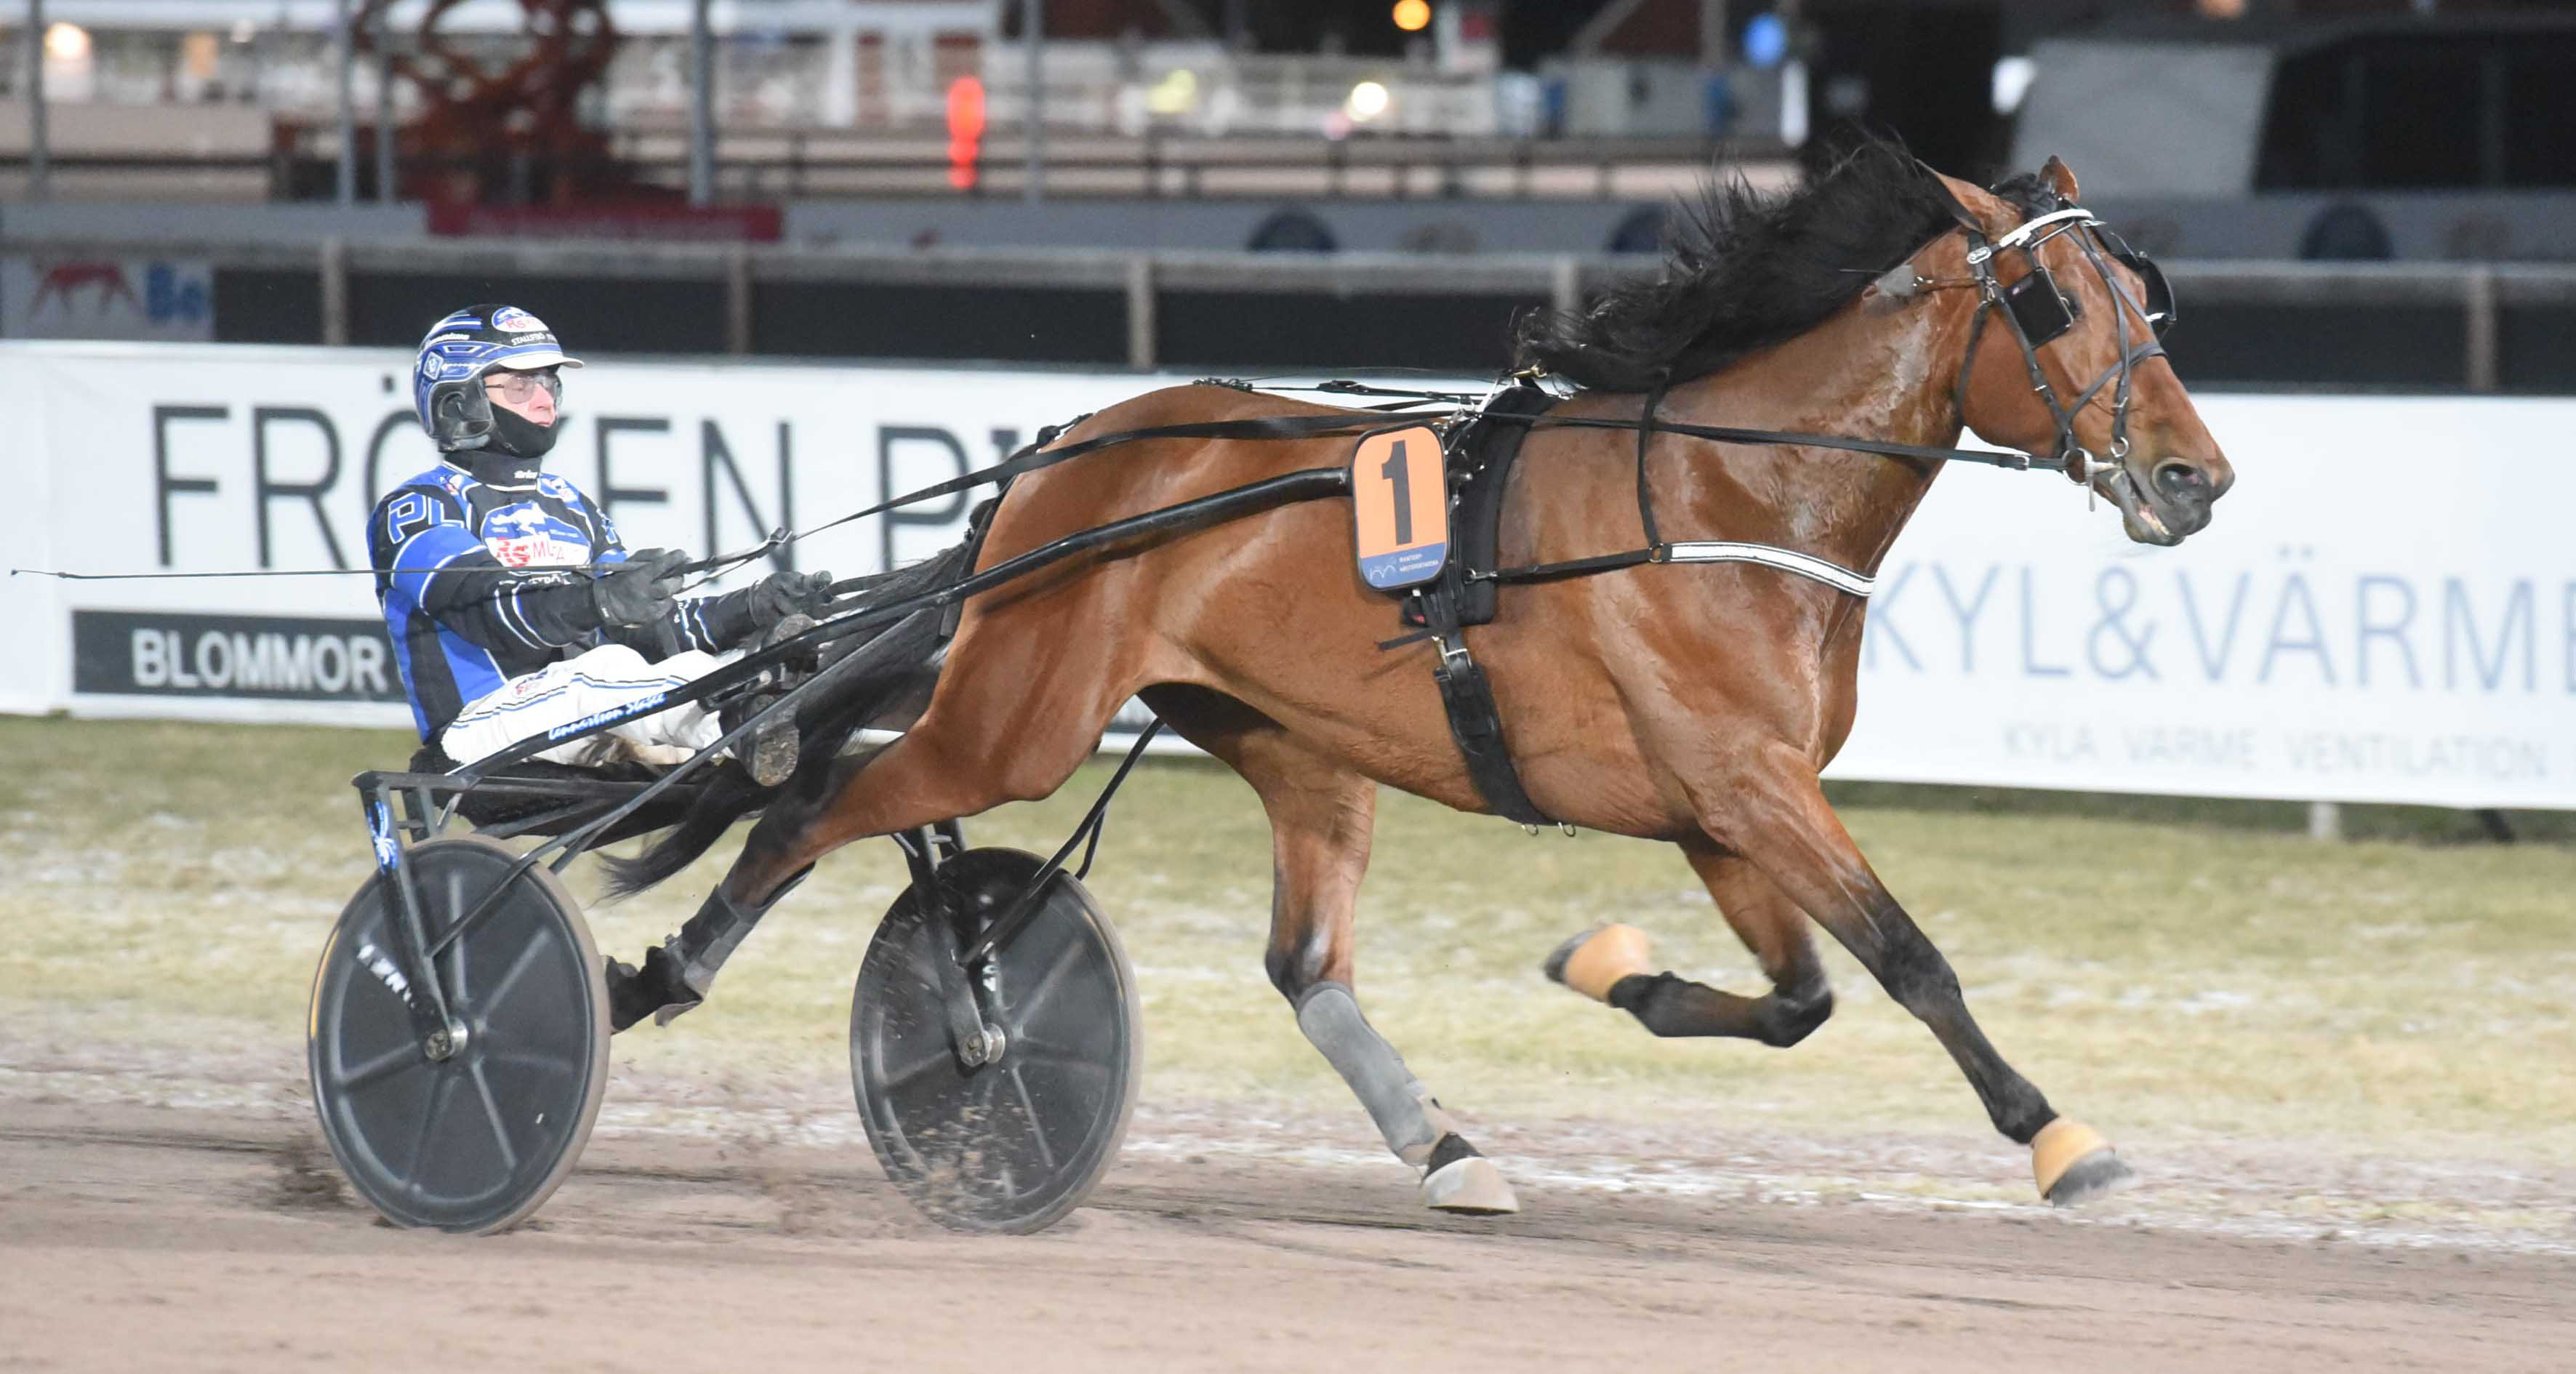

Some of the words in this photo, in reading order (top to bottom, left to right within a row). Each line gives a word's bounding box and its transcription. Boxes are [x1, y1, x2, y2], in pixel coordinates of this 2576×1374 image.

[152, 374, 792, 586] FREN
[1381, 440, 1412, 546] 1
[132, 628, 388, 693] BLOMMOR
[1865, 544, 2576, 695] KYL&VÄRM
